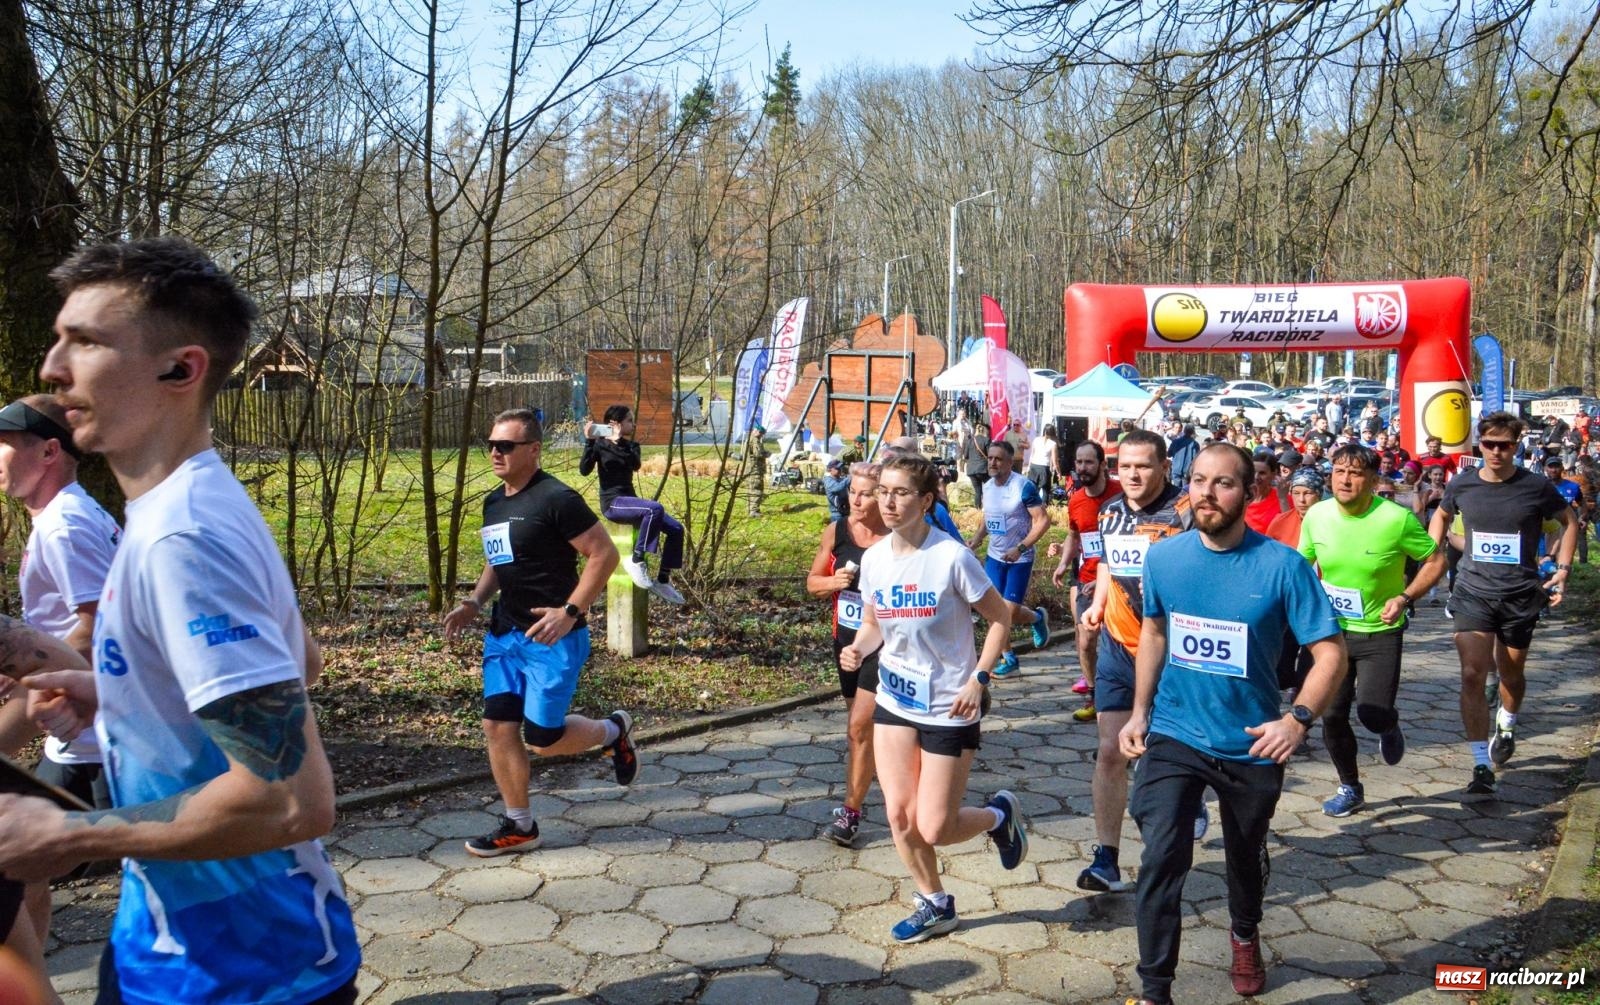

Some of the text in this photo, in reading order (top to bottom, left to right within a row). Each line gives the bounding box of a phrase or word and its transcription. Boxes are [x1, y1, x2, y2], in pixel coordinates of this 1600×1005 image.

[1254, 292, 1298, 303] BIEG
[1218, 309, 1339, 323] TWARDZIELA
[1228, 327, 1325, 343] RACIBÓRZ
[486, 538, 504, 555] 001
[1481, 543, 1511, 555] 092
[1112, 549, 1142, 564] 042
[1327, 594, 1353, 610] 062
[845, 604, 862, 619] 01
[1182, 634, 1232, 660] 095
[888, 671, 917, 697] 015
